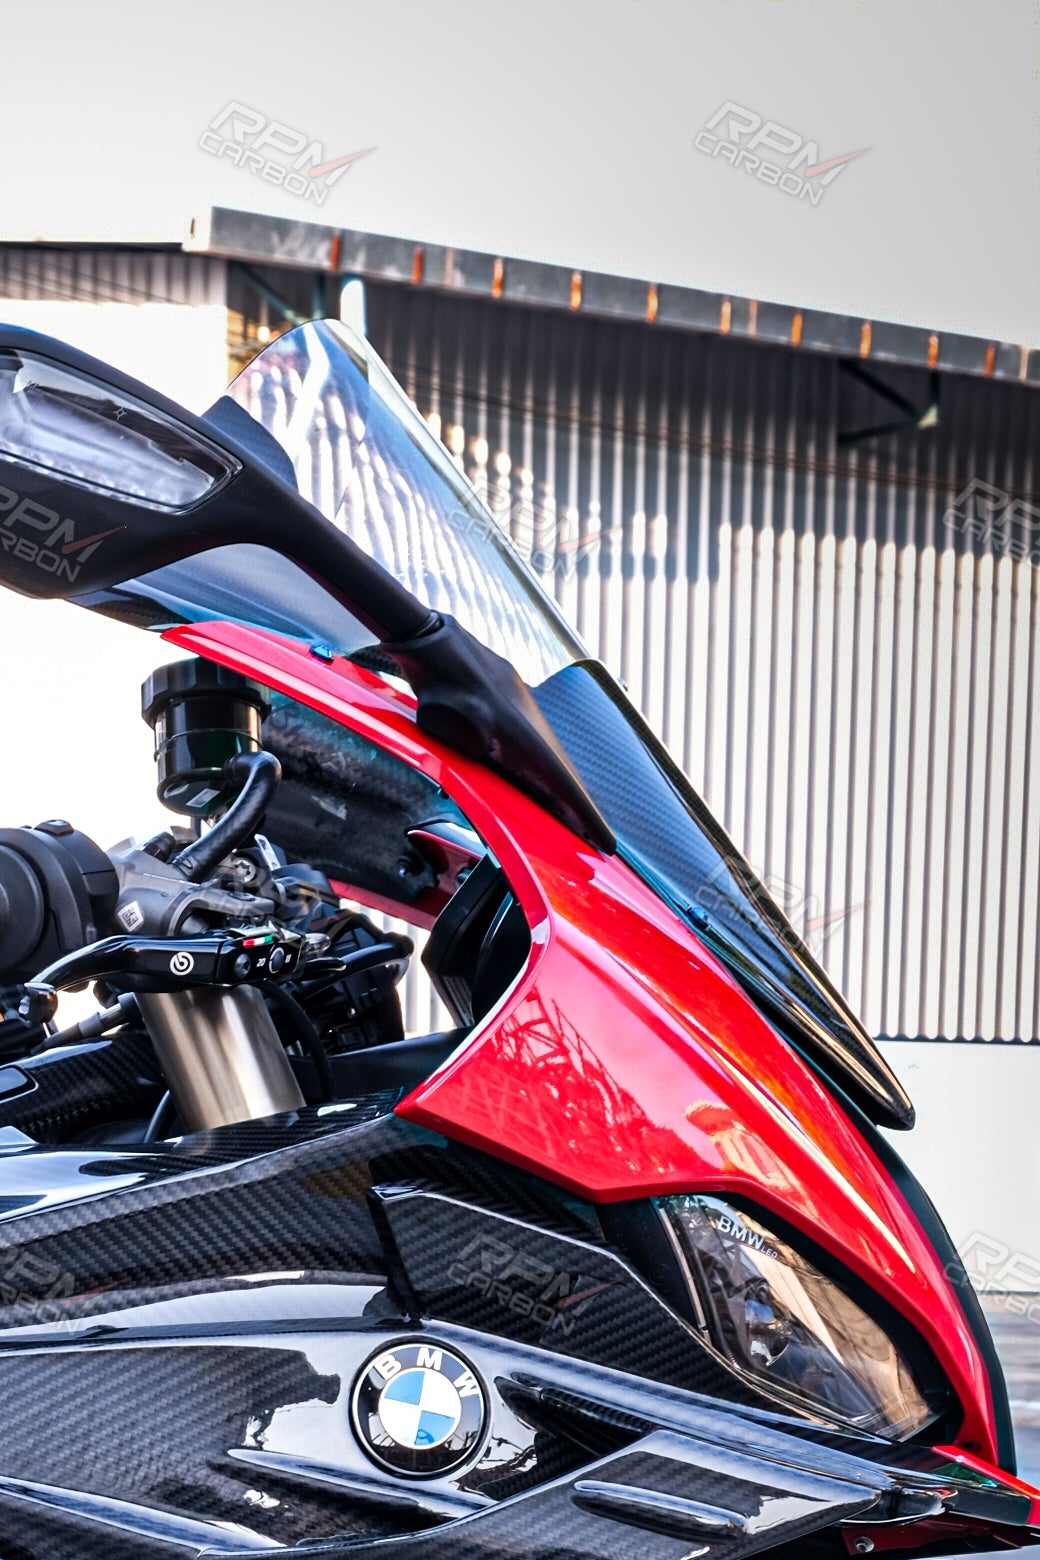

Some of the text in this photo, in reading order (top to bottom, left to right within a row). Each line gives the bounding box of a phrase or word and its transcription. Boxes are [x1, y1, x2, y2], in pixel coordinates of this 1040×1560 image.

[718, 1215, 778, 1259] BMW LED
[373, 1347, 480, 1398] BMW
